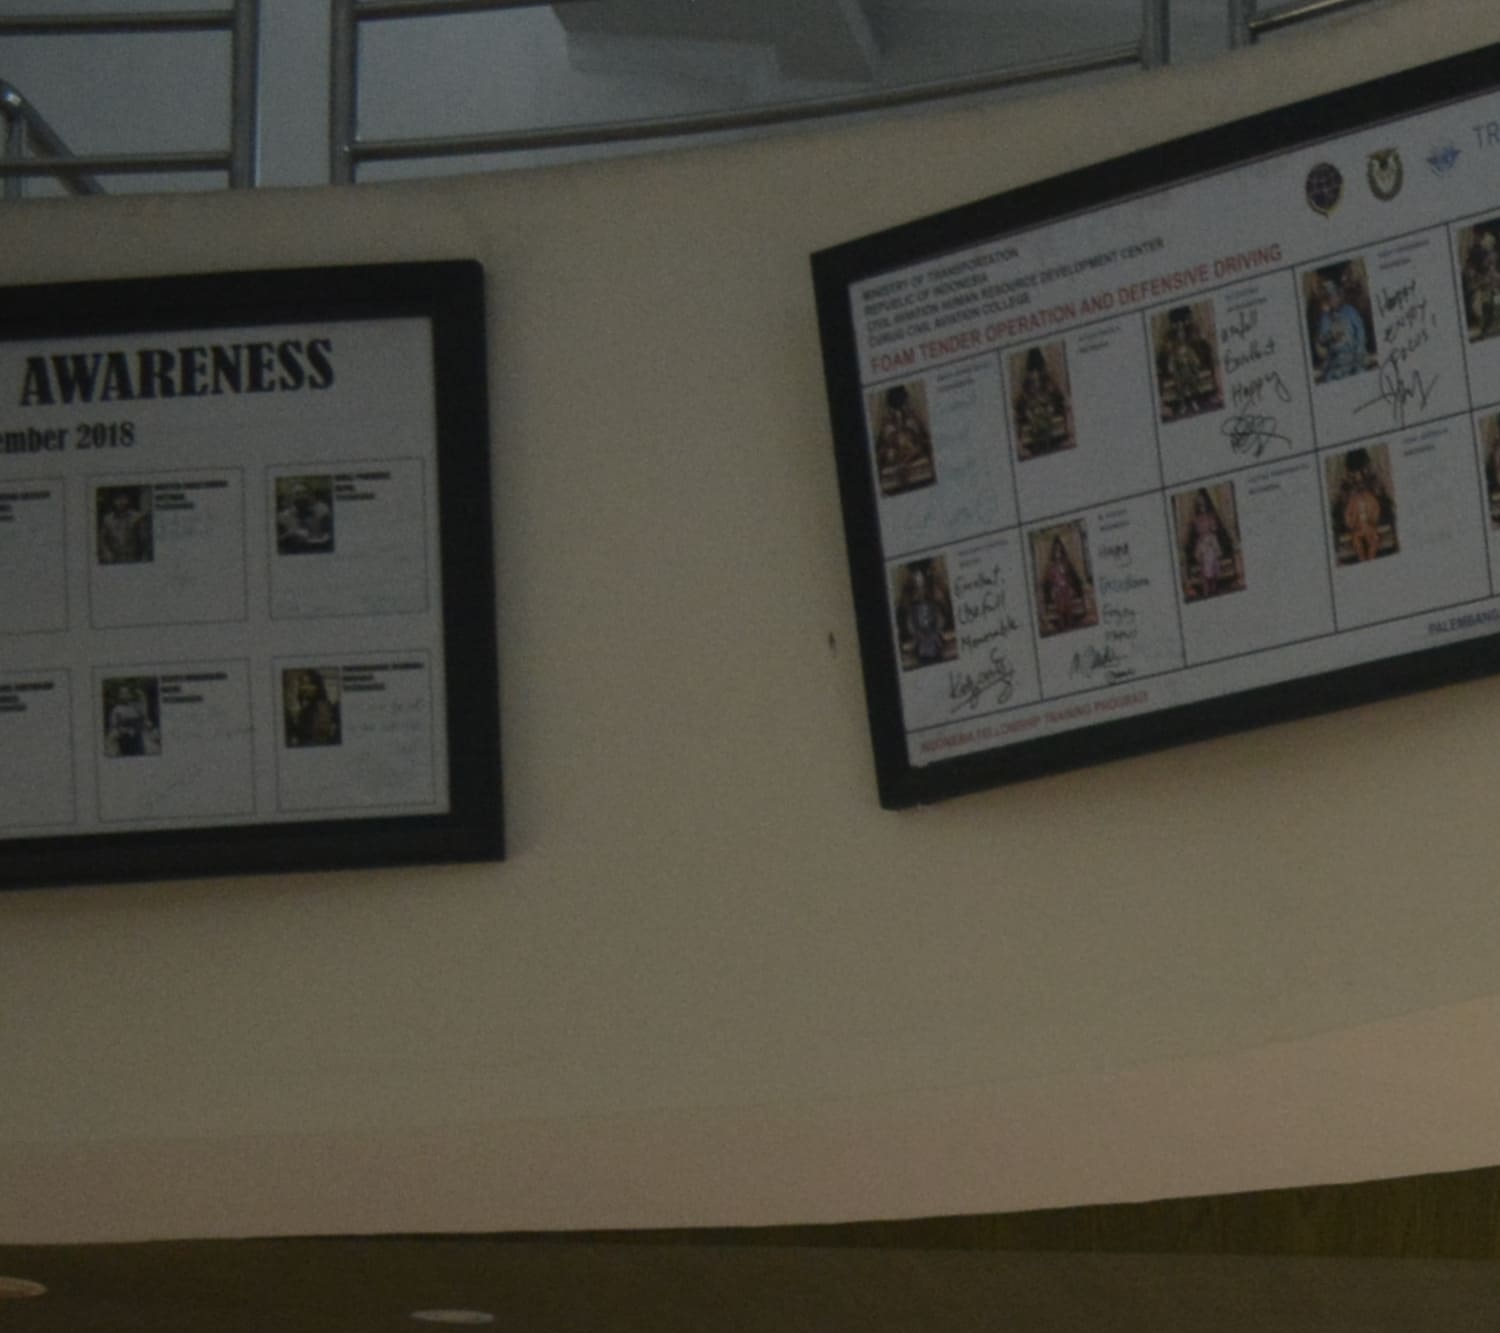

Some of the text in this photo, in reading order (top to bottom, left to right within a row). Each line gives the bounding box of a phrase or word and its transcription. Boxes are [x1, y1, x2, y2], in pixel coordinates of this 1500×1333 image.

[1039, 249, 1118, 284] DEVELOPMENT
[1120, 236, 1165, 261] CENTER
[870, 347, 916, 375] FOAM
[919, 328, 982, 361] TENDER
[984, 300, 1077, 343] OPERATION
[1079, 290, 1115, 316] AND
[1116, 262, 1211, 305] DEFENSIVE
[1212, 241, 1284, 280] DRIVING
[19, 337, 337, 408] AWARENESS
[75, 419, 138, 451] 2018
